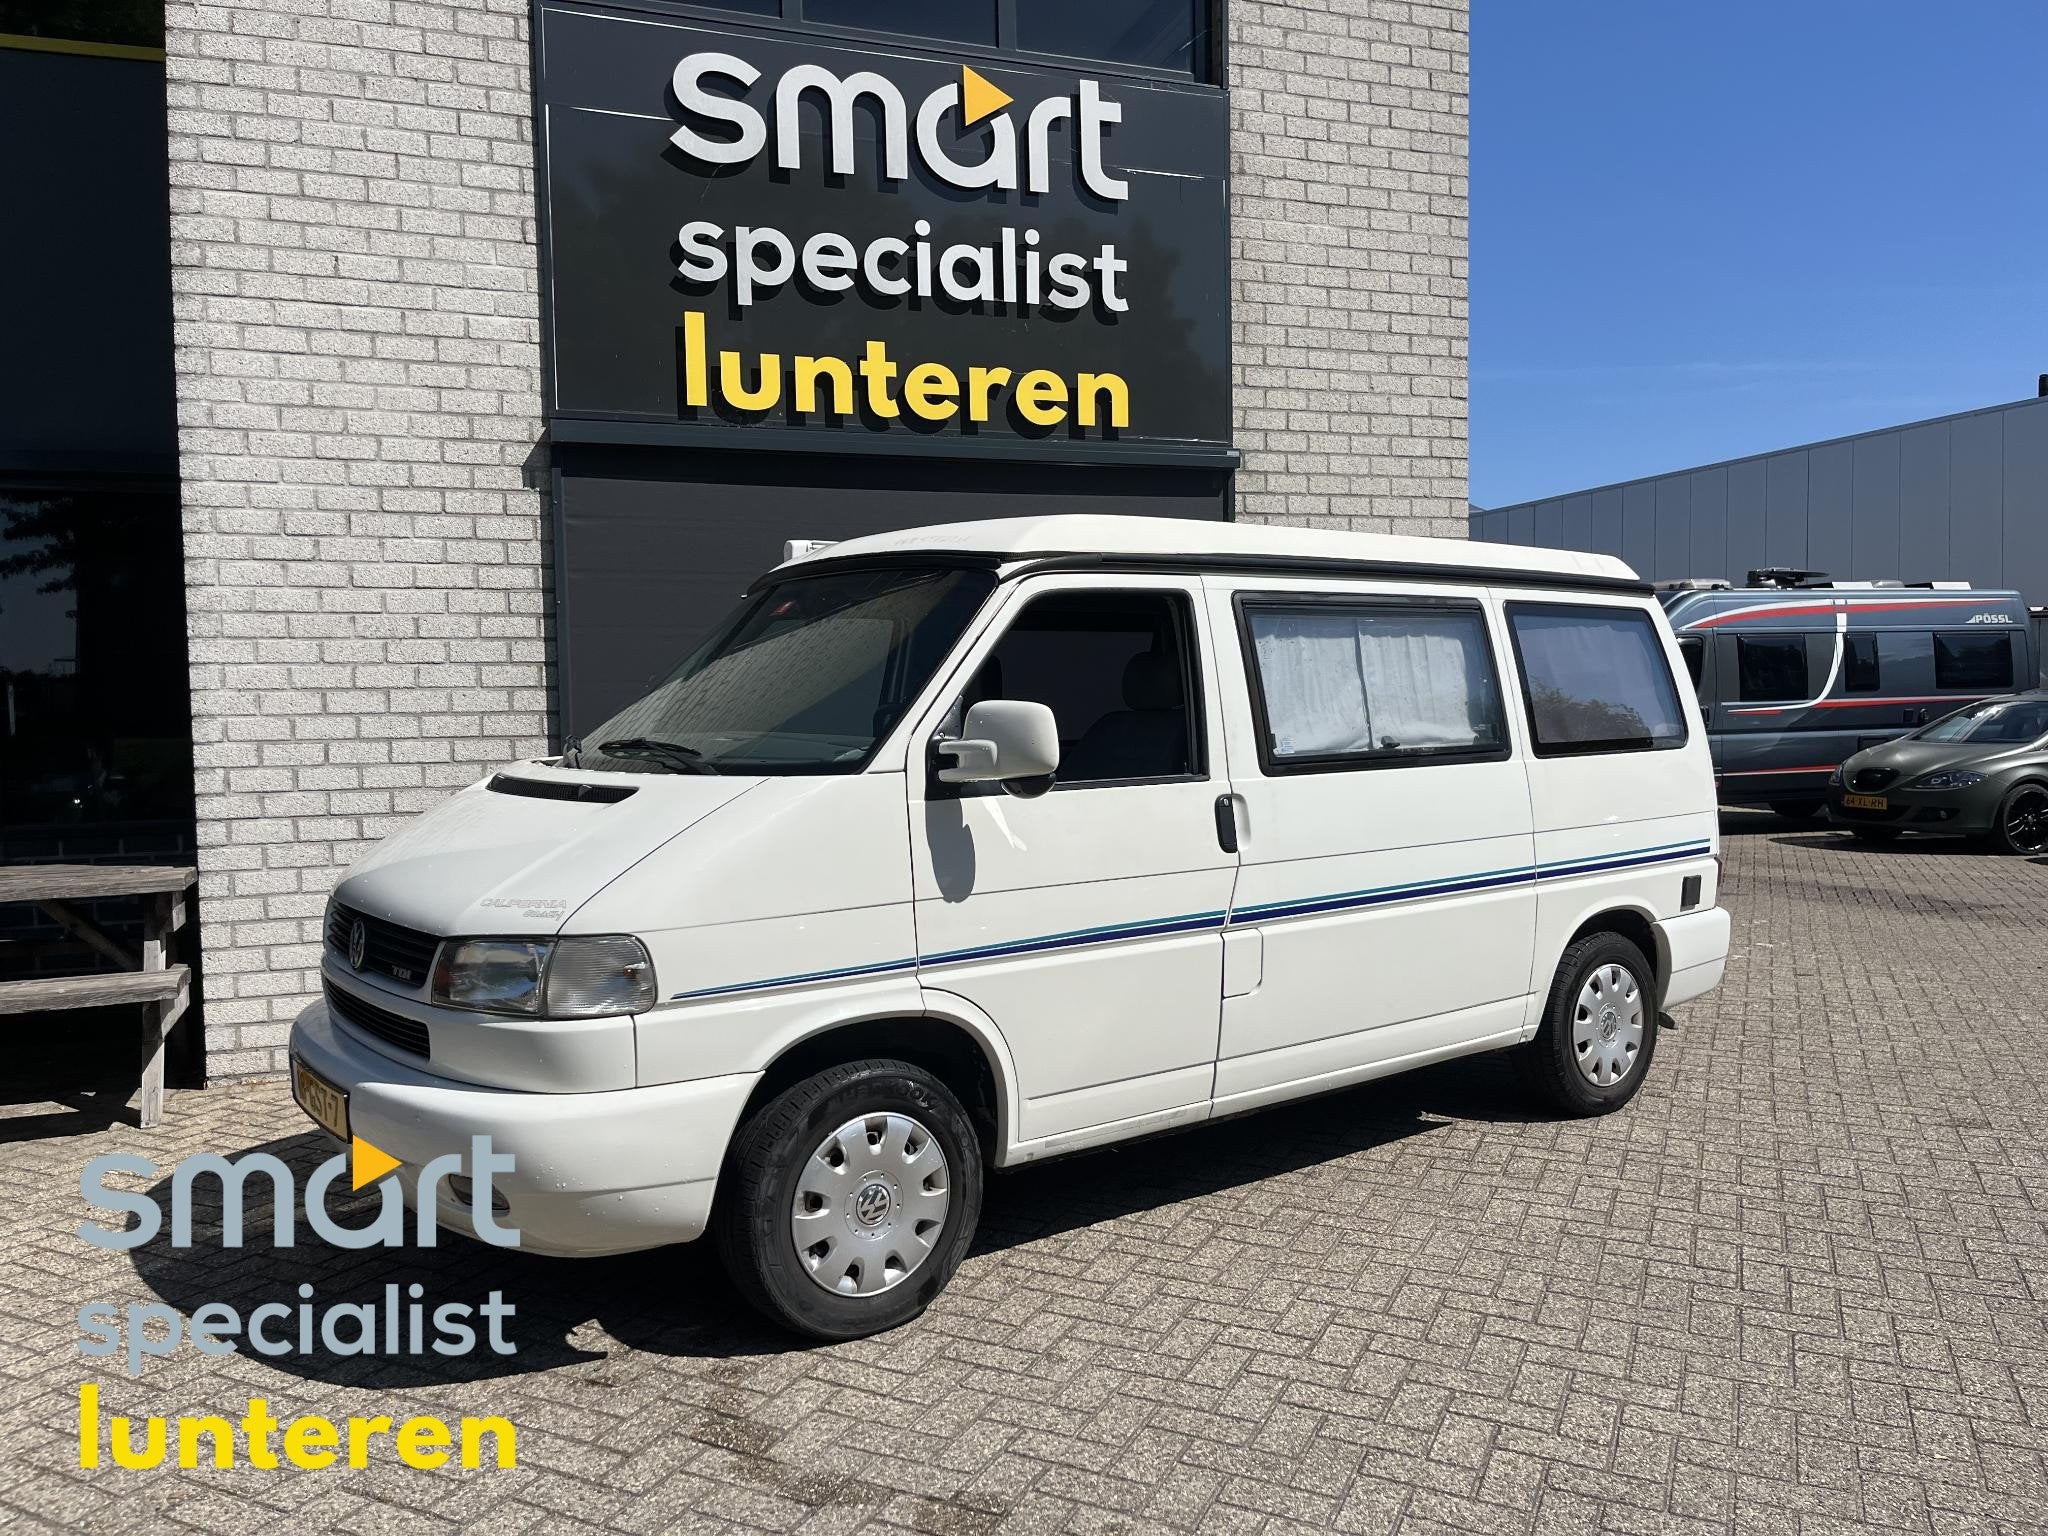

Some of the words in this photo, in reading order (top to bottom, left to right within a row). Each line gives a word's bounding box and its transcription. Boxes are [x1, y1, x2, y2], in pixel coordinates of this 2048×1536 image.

[669, 52, 1129, 201] smart
[678, 220, 1130, 311] specialist
[684, 311, 1129, 427] lunteren
[1974, 612, 2014, 624] PÖSSL
